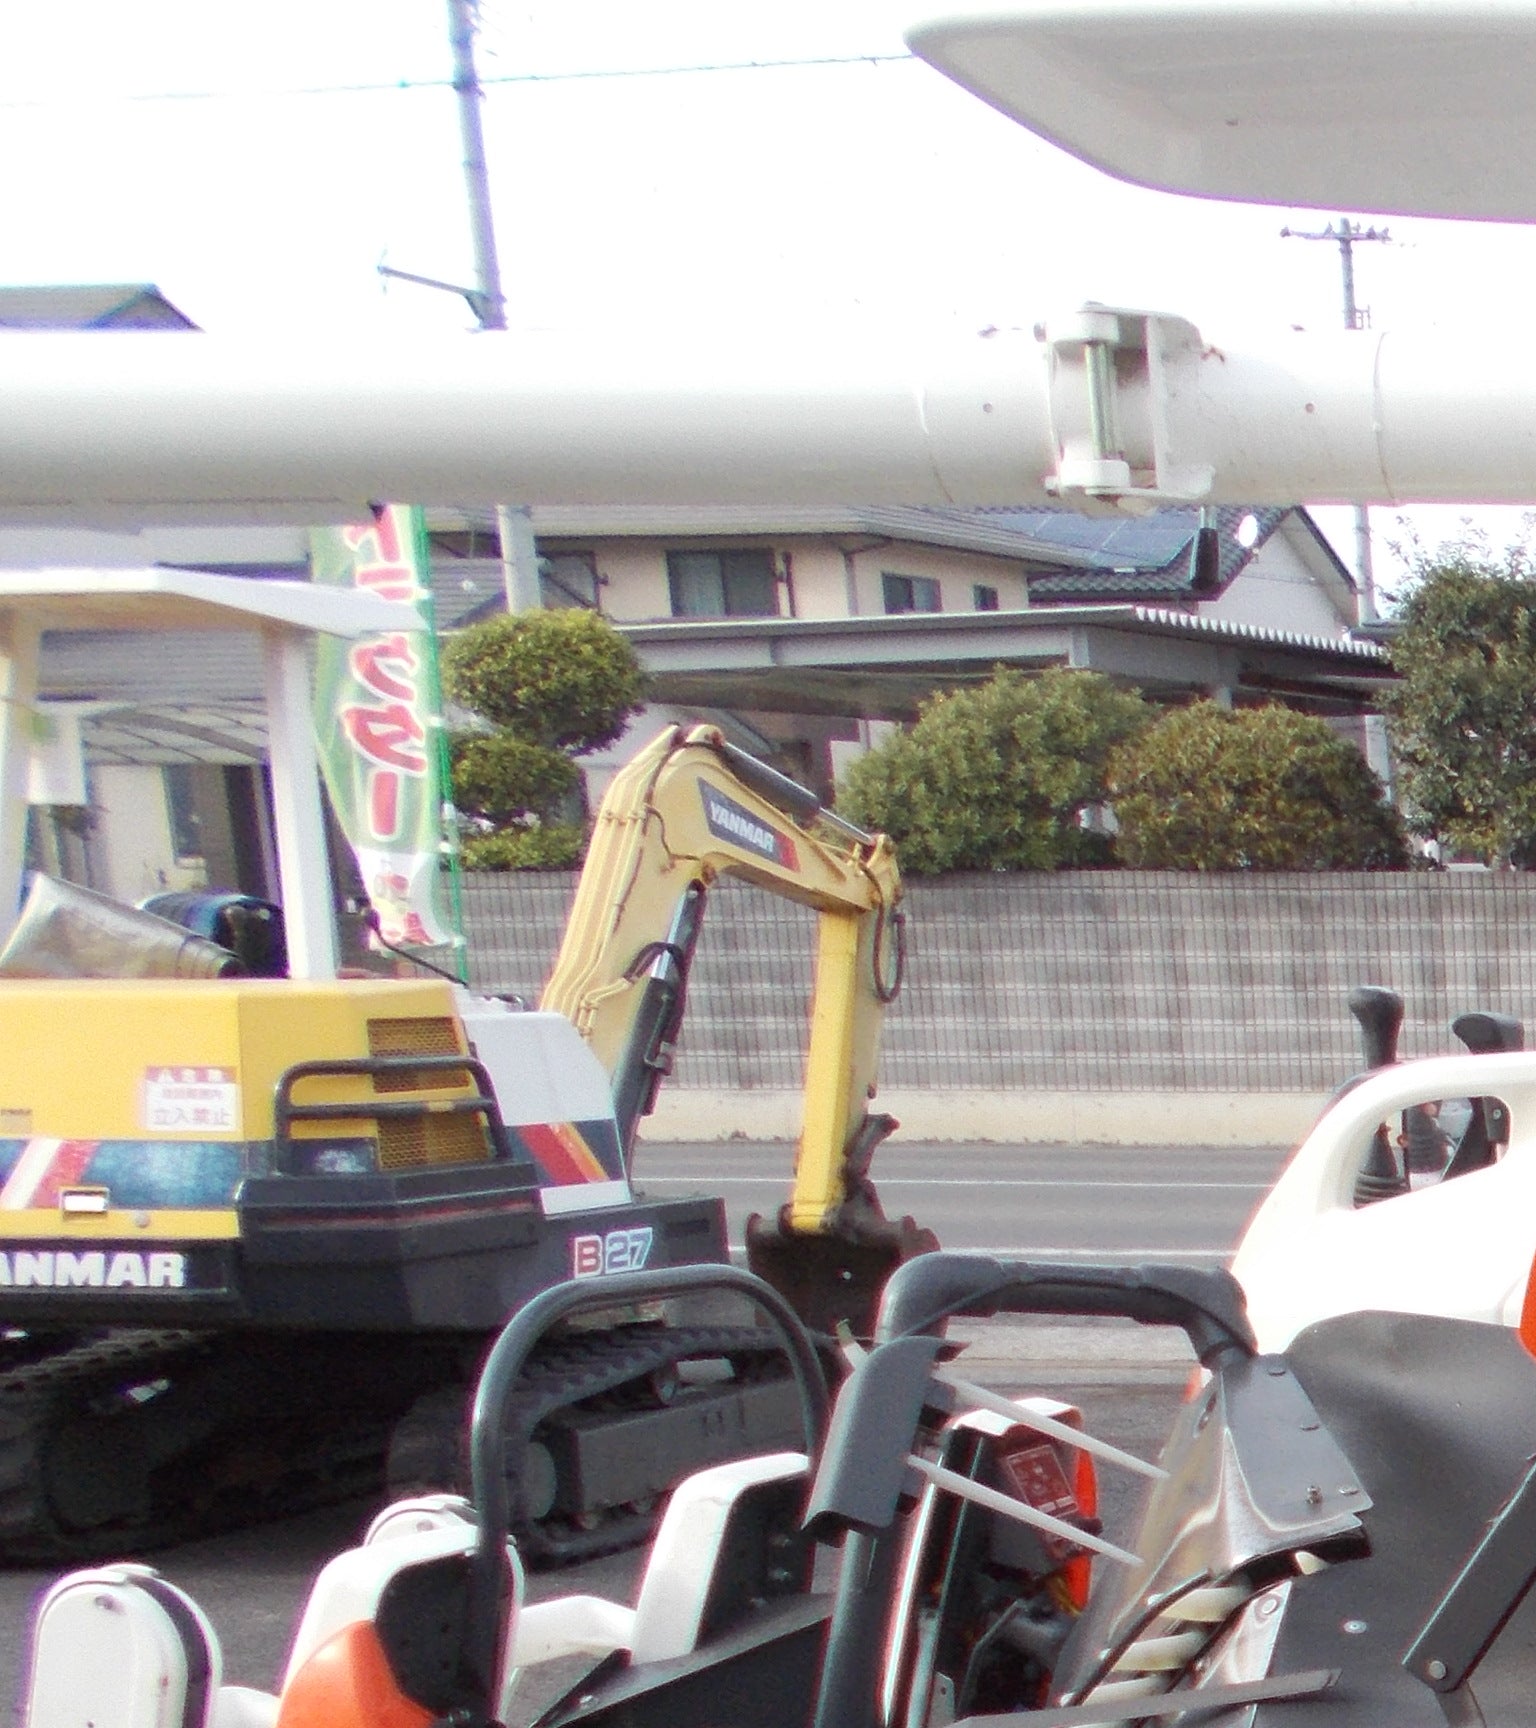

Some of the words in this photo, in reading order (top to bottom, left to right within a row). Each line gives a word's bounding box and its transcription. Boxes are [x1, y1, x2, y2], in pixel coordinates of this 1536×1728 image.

[710, 800, 774, 853] YANMAR
[0, 1250, 185, 1286] NMAR
[574, 1227, 653, 1278] B27
